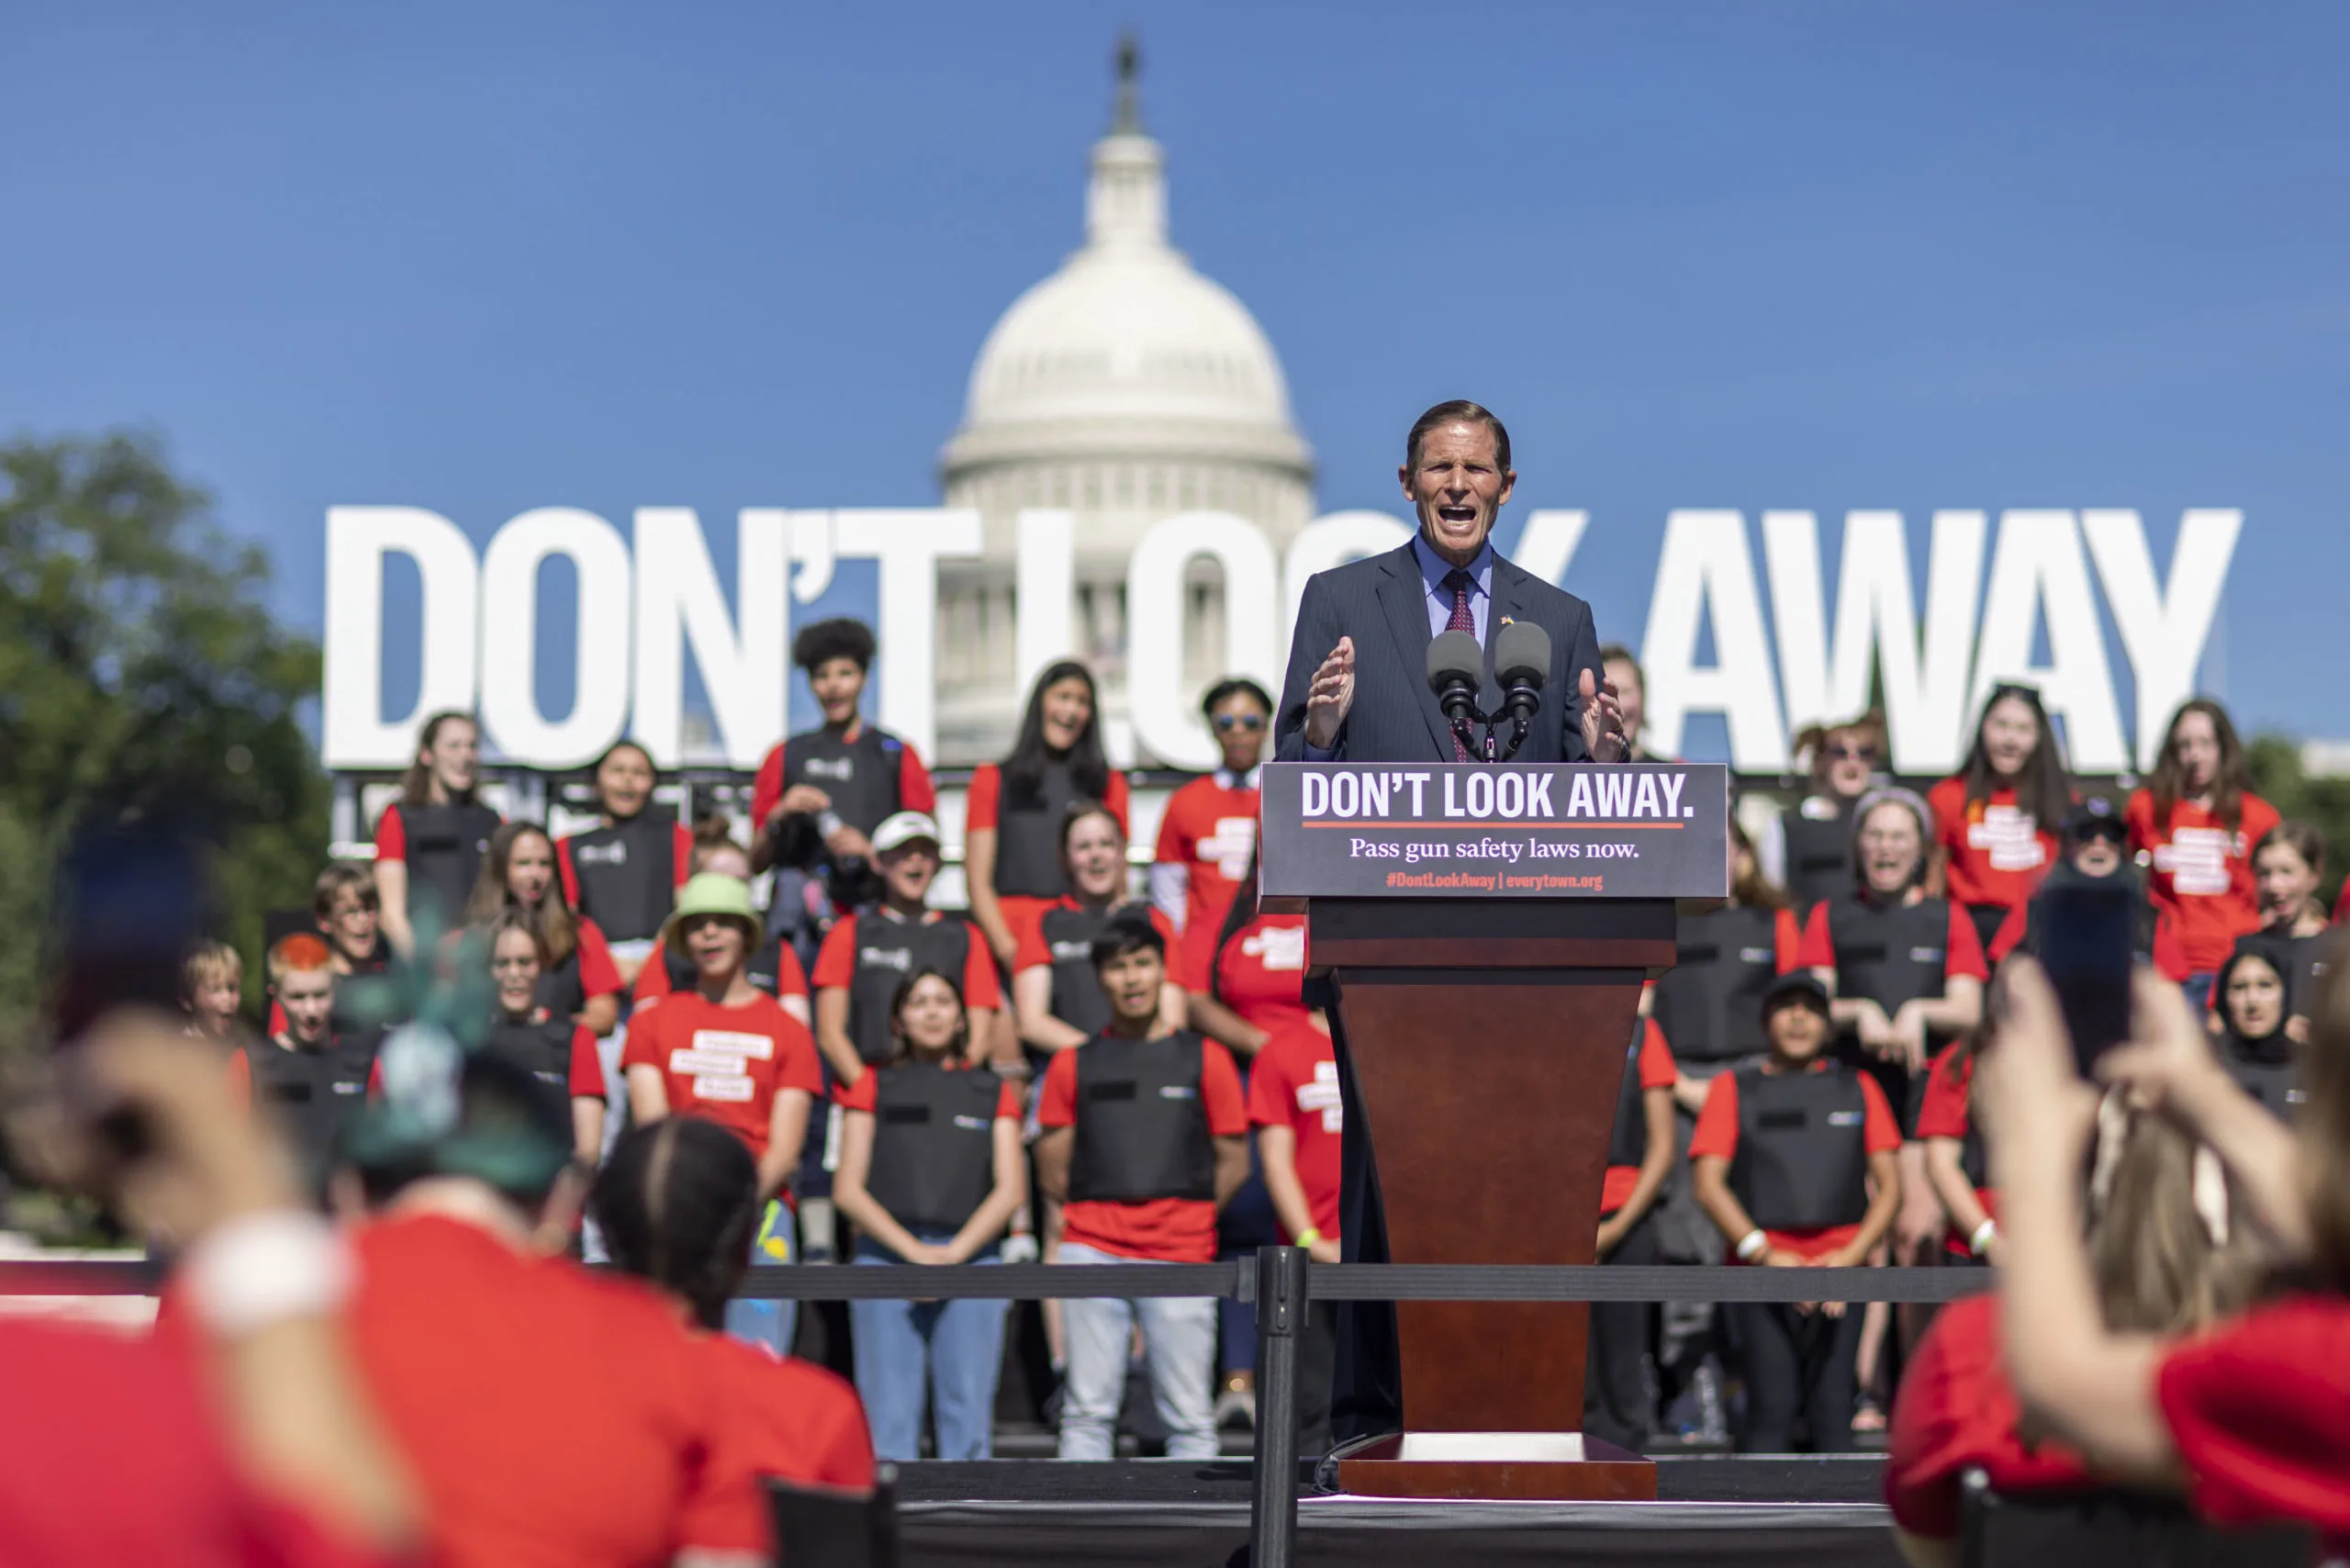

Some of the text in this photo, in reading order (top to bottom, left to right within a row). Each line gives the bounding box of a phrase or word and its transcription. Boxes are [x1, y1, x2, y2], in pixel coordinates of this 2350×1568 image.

[325, 505, 2246, 776] DON’T LO AWAY
[1301, 771, 1695, 819] DON’T LOOK AWAY.
[1349, 836, 1640, 864] Pass gun safety laws now.
[1386, 872, 1496, 891] #DontLookAway
[1505, 874, 1604, 891] everytown.org
